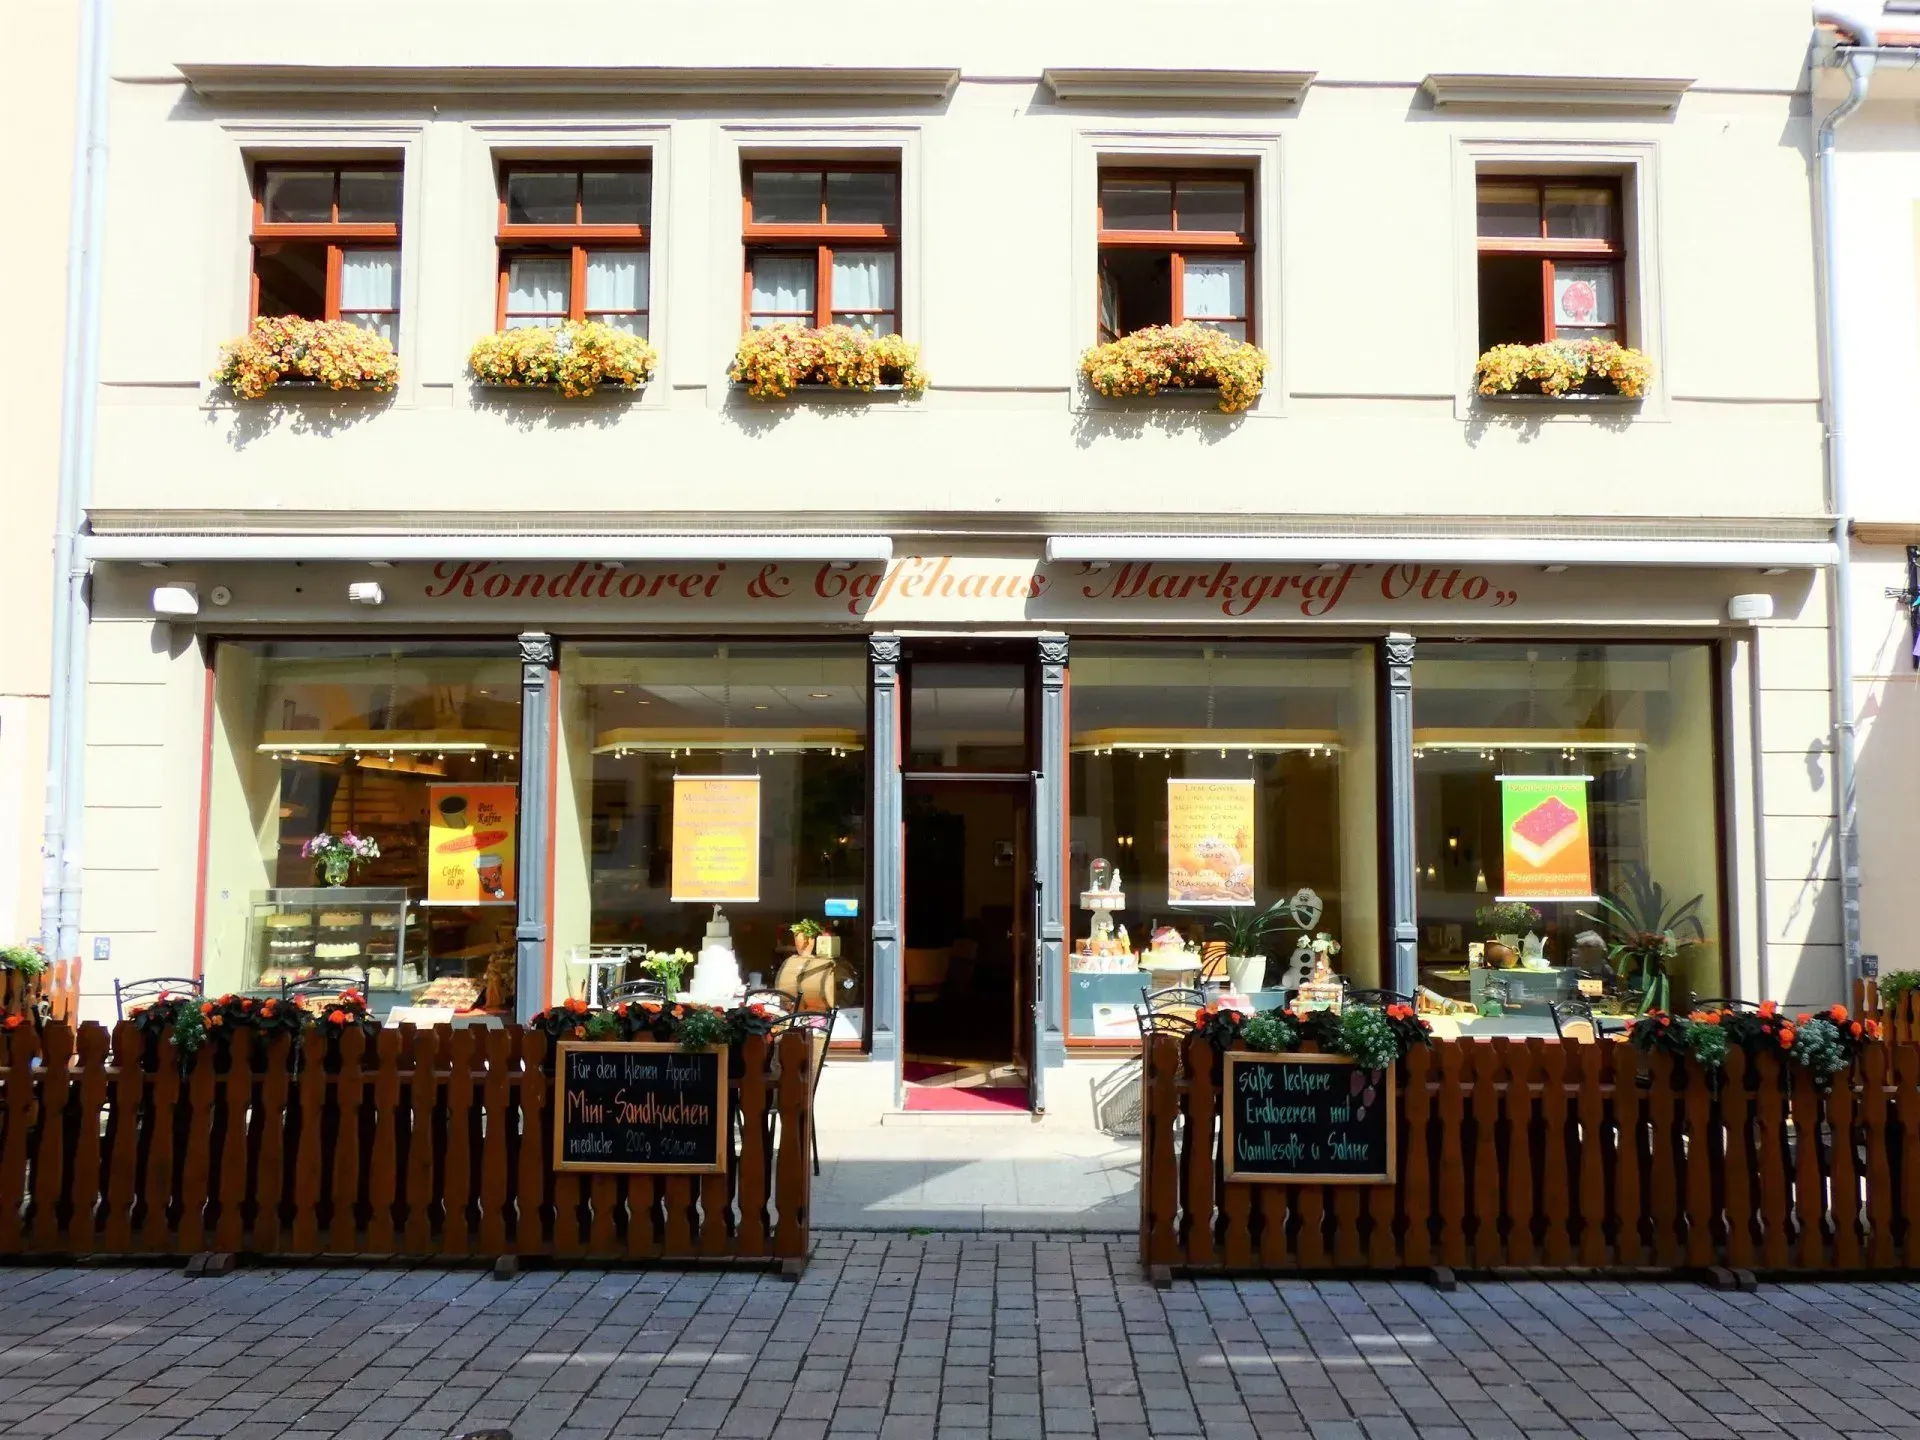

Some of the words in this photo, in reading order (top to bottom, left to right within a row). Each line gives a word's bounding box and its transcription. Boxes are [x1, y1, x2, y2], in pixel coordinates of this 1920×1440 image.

[425, 560, 727, 598] Konditorei
[747, 562, 794, 598] &
[814, 555, 1050, 615] Caféhaus
[568, 1052, 591, 1080] Für
[596, 1055, 617, 1079] den
[1283, 1064, 1331, 1095] leckere
[567, 1088, 709, 1130] Mini-Sandkuchen
[1246, 1097, 1317, 1124] Erdbeeren
[1330, 1094, 1351, 1123] mit
[1327, 1131, 1370, 1161] Sahne
